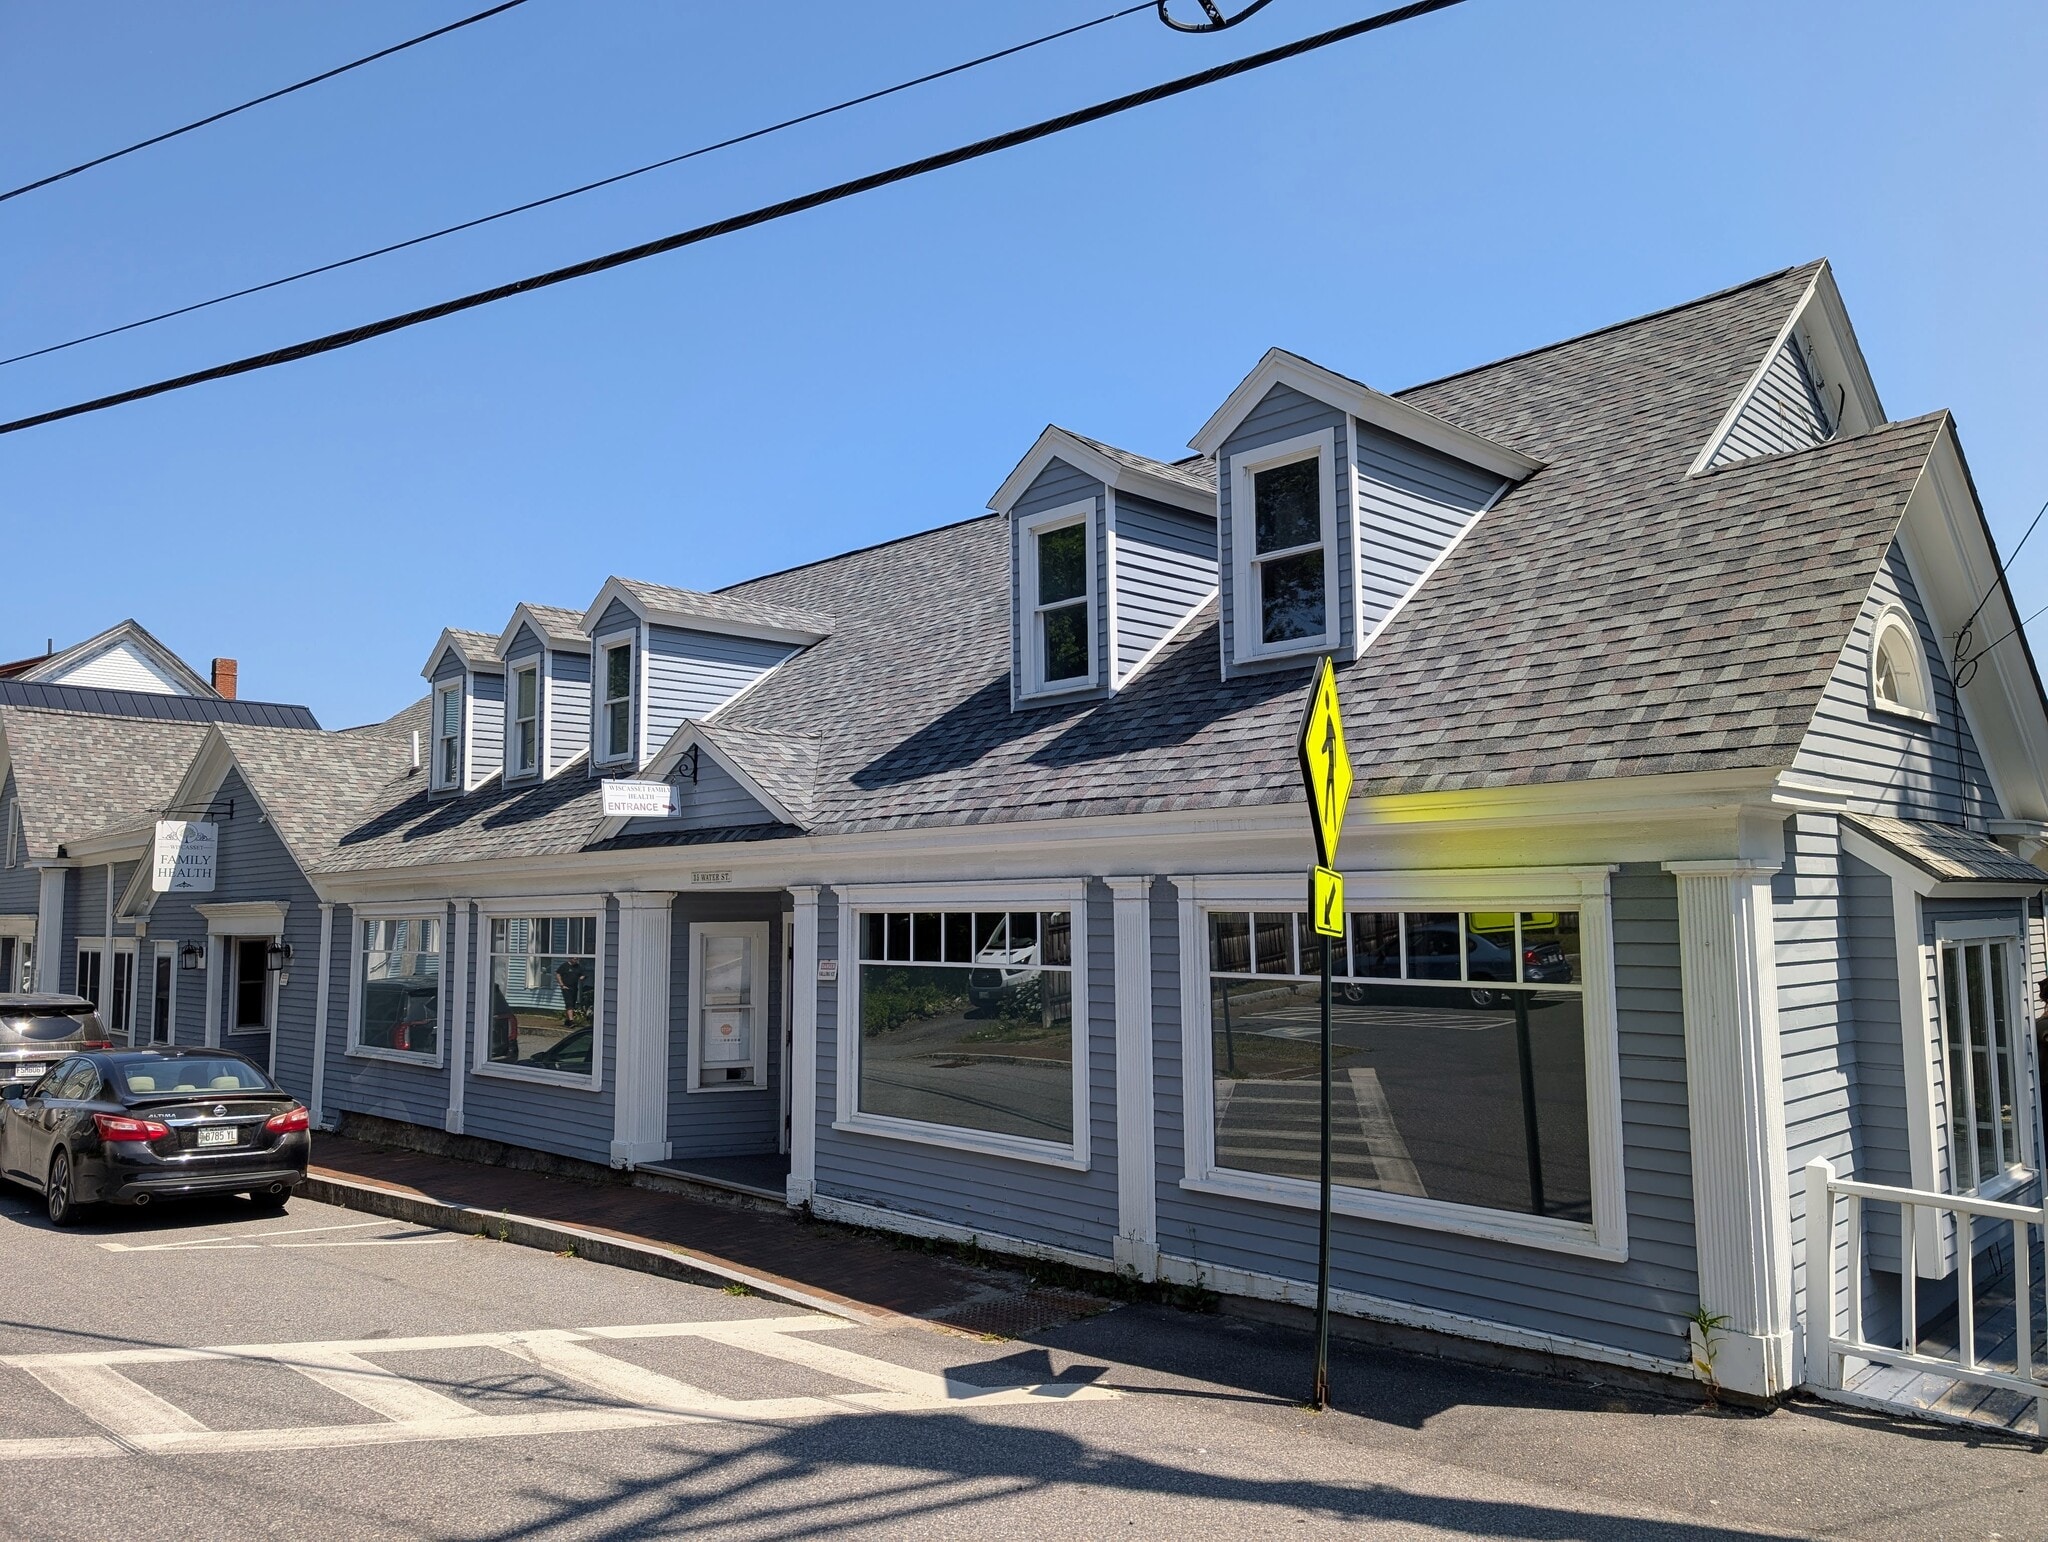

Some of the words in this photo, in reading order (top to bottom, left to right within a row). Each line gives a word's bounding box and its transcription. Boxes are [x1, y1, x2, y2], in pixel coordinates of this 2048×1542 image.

[608, 802, 659, 811] ENTRANCE
[160, 854, 212, 865] FAMILY
[157, 867, 213, 878] HEALTH
[700, 873, 720, 881] WATER
